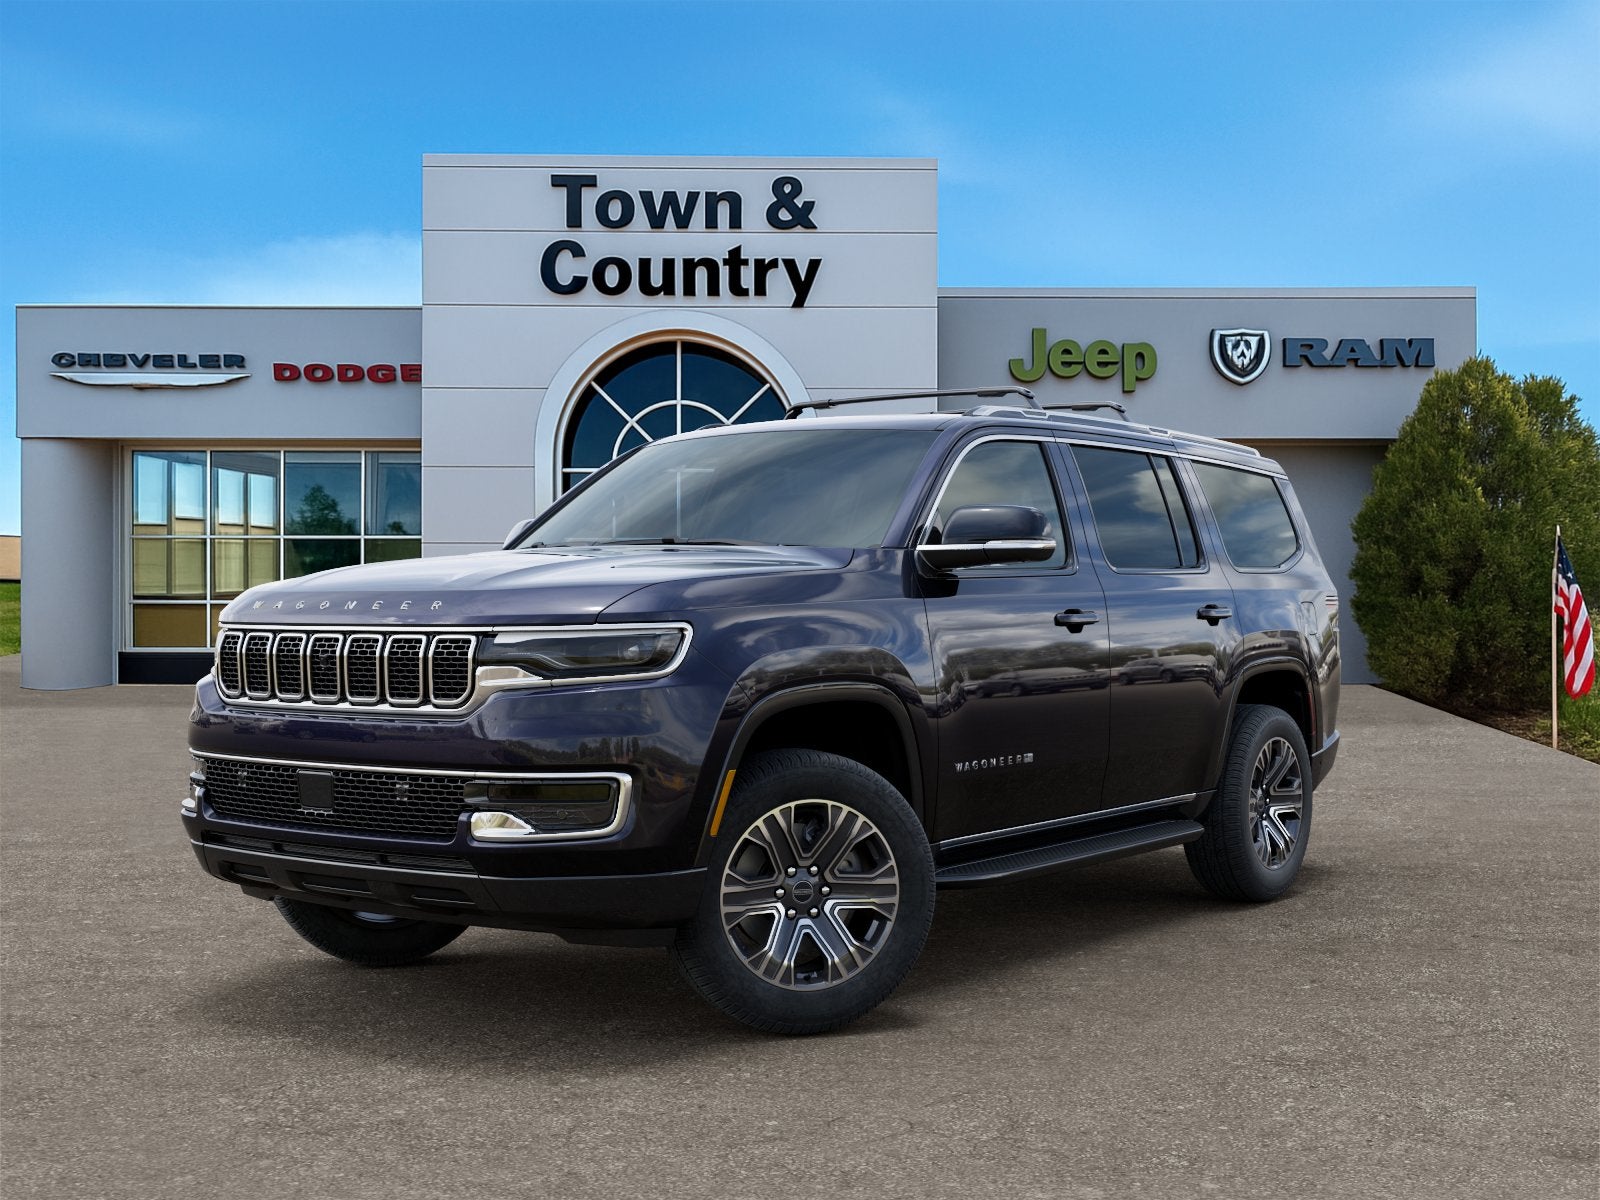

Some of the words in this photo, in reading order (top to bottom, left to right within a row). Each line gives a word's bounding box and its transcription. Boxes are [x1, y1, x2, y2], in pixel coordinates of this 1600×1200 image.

[550, 173, 743, 230] Town
[764, 175, 818, 230] &
[539, 239, 822, 308] Country
[1008, 327, 1158, 393] Jeep
[1281, 337, 1436, 368] RAM
[272, 362, 422, 384] DODGE
[252, 600, 443, 611] WAGONEER
[954, 753, 1023, 773] WAGONEER
